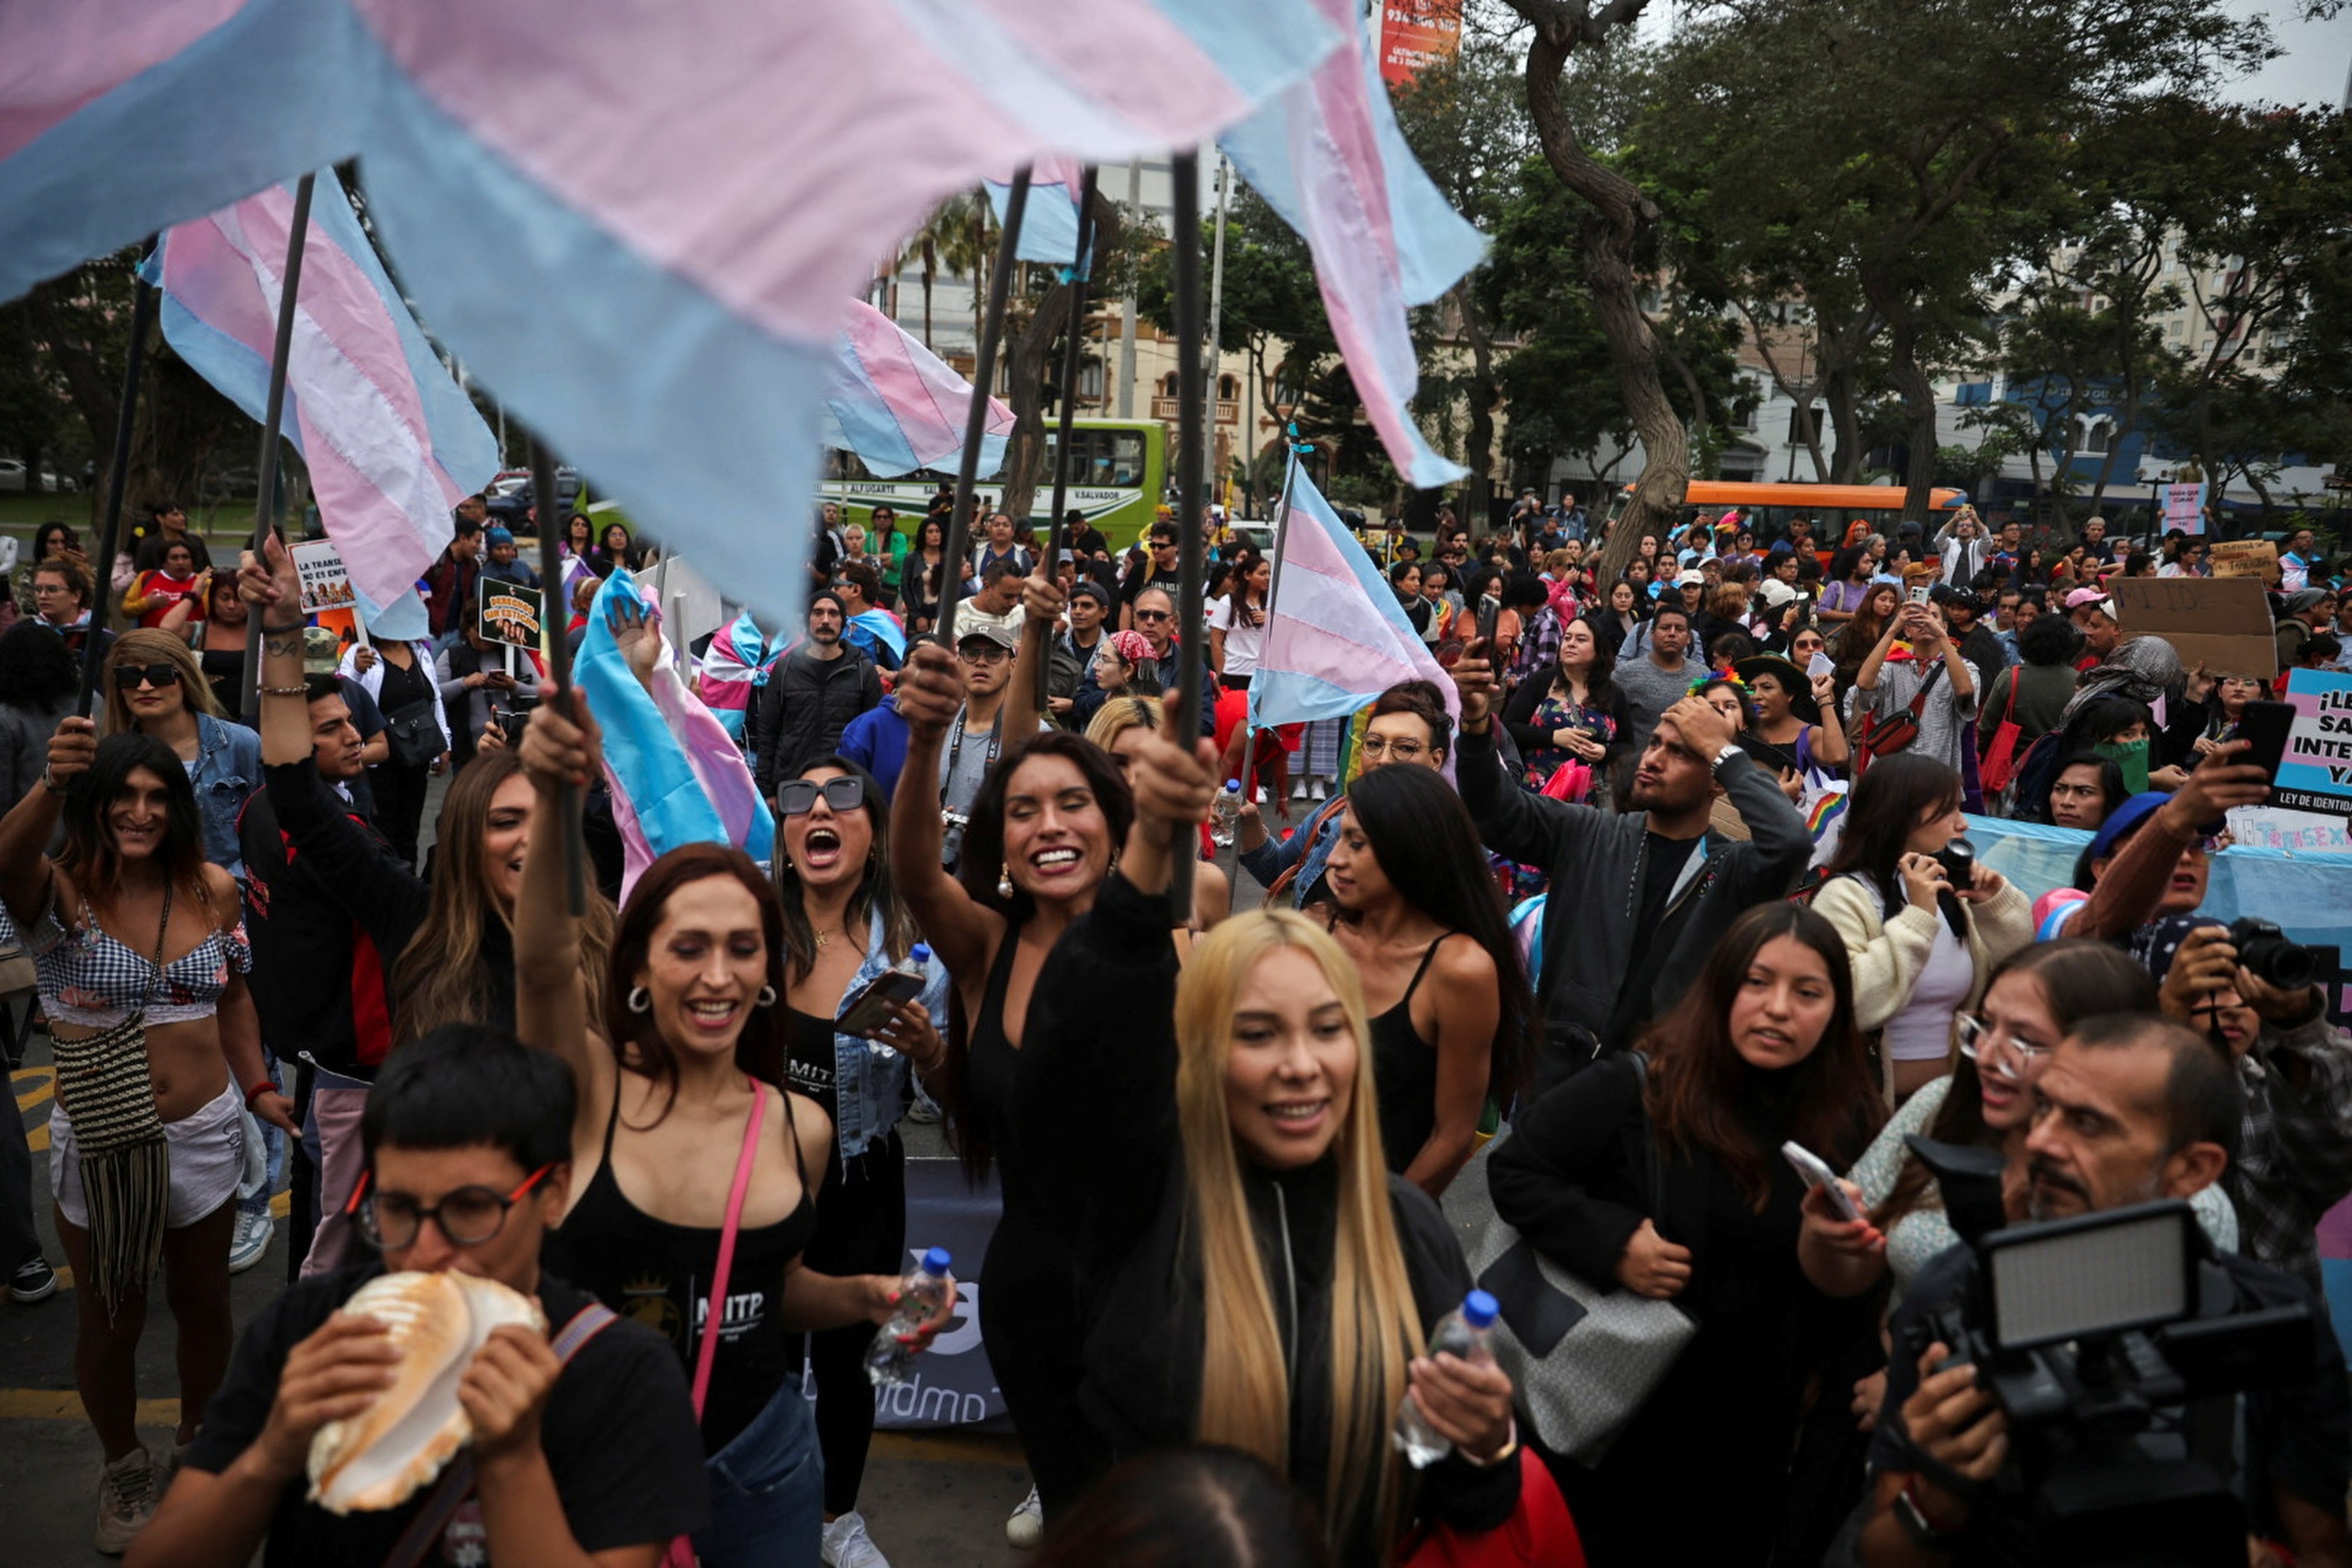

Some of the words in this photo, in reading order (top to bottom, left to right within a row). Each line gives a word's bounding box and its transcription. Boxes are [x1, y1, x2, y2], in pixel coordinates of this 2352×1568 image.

[299, 563, 310, 571] LA
[2280, 792, 2298, 804] LEY
[2298, 794, 2311, 807] DE
[789, 1058, 836, 1084] MIT
